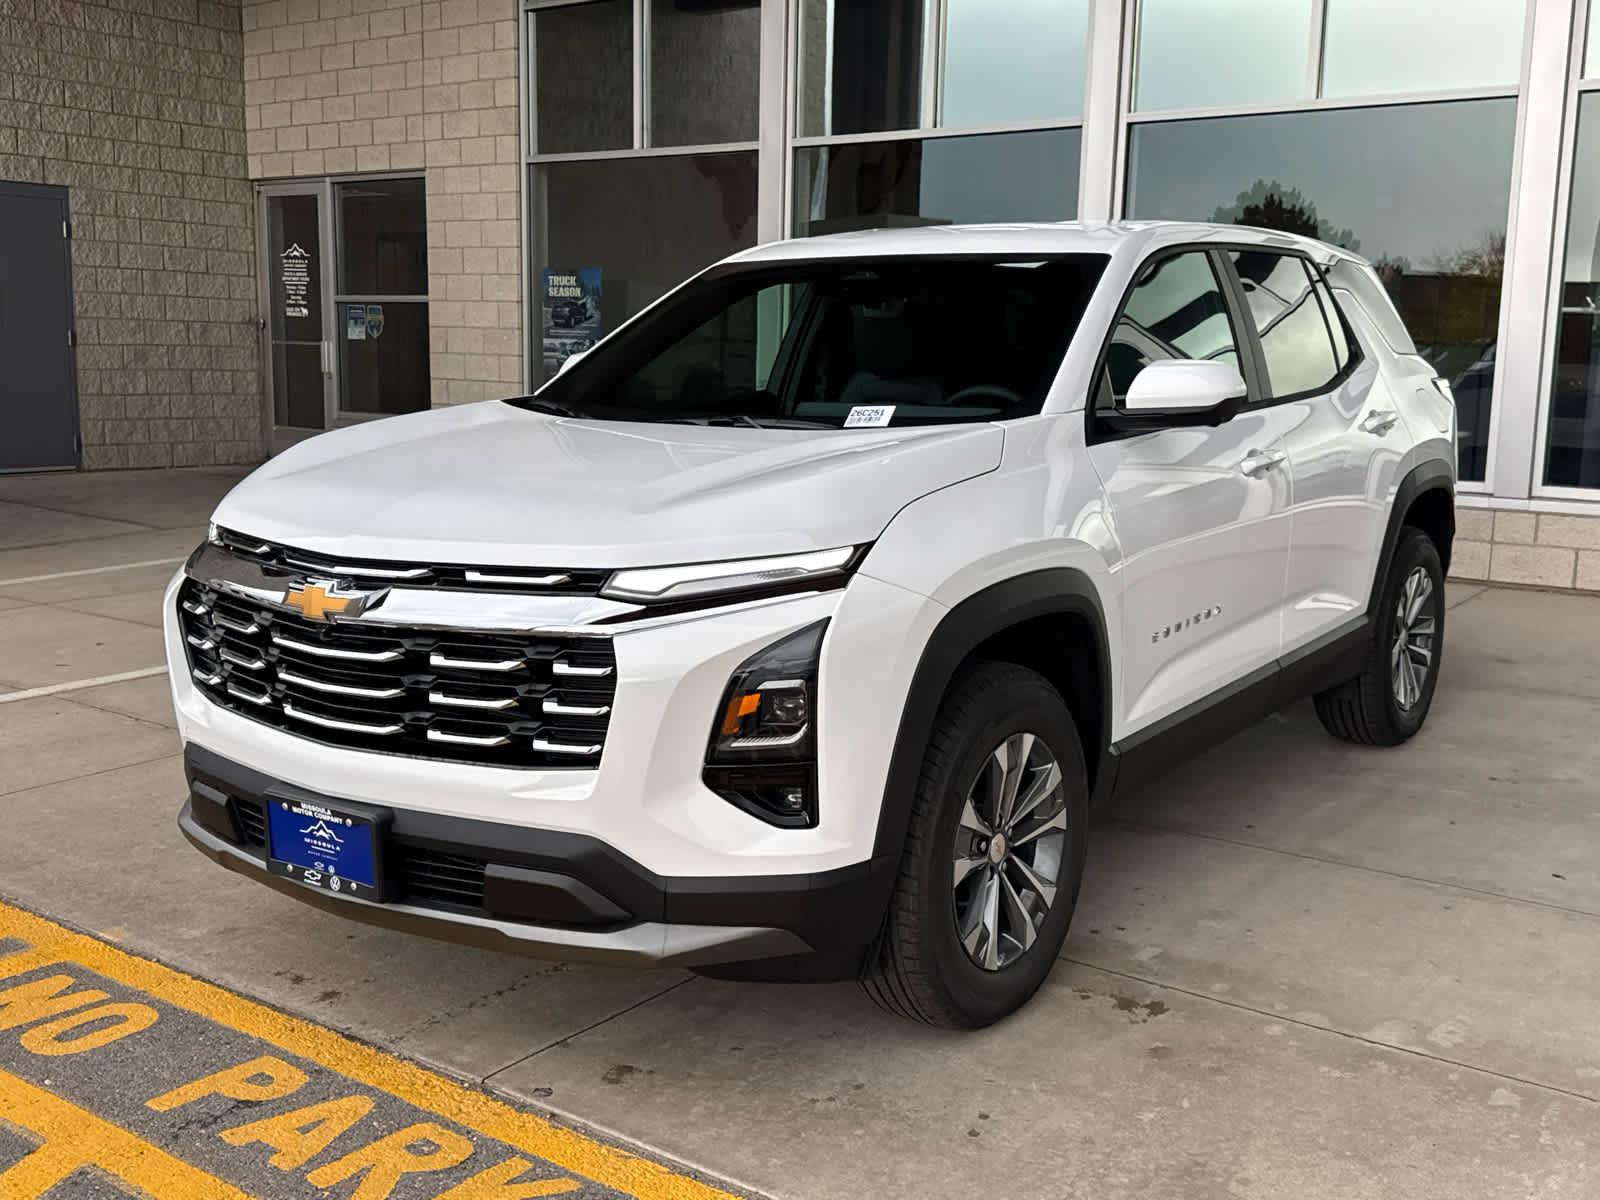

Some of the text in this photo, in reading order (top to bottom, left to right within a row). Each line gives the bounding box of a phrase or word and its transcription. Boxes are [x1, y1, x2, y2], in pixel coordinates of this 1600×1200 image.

[548, 275, 576, 286] TRUCK
[548, 287, 581, 297] SEASON
[291, 806, 343, 825] MOTOR COMPANY
[304, 837, 341, 850] MISSOULA
[0, 974, 159, 1056] NO
